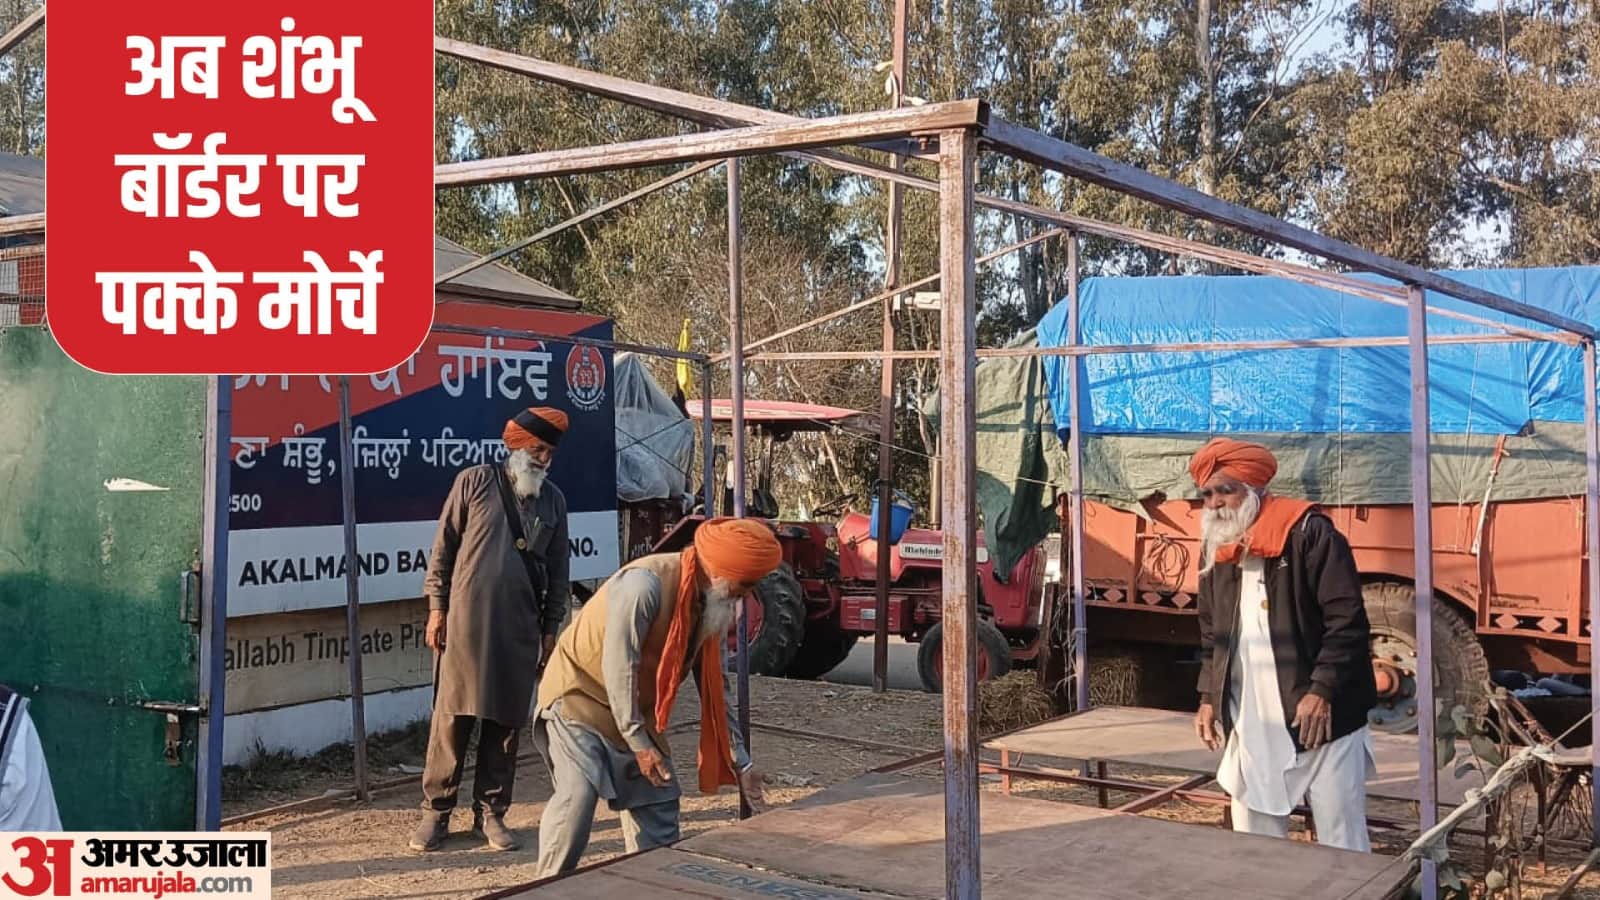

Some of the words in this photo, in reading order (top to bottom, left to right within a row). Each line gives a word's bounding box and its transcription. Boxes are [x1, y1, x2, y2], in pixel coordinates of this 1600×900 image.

[230, 437, 269, 469] ਣਾ
[421, 427, 510, 467] ਪਟਿਆਲ
[229, 494, 262, 512] 500
[239, 552, 390, 587] AKALMAND
[397, 549, 432, 573] BA
[568, 537, 598, 558] NO.
[224, 636, 294, 670] allabh
[303, 628, 393, 664] Tinpate
